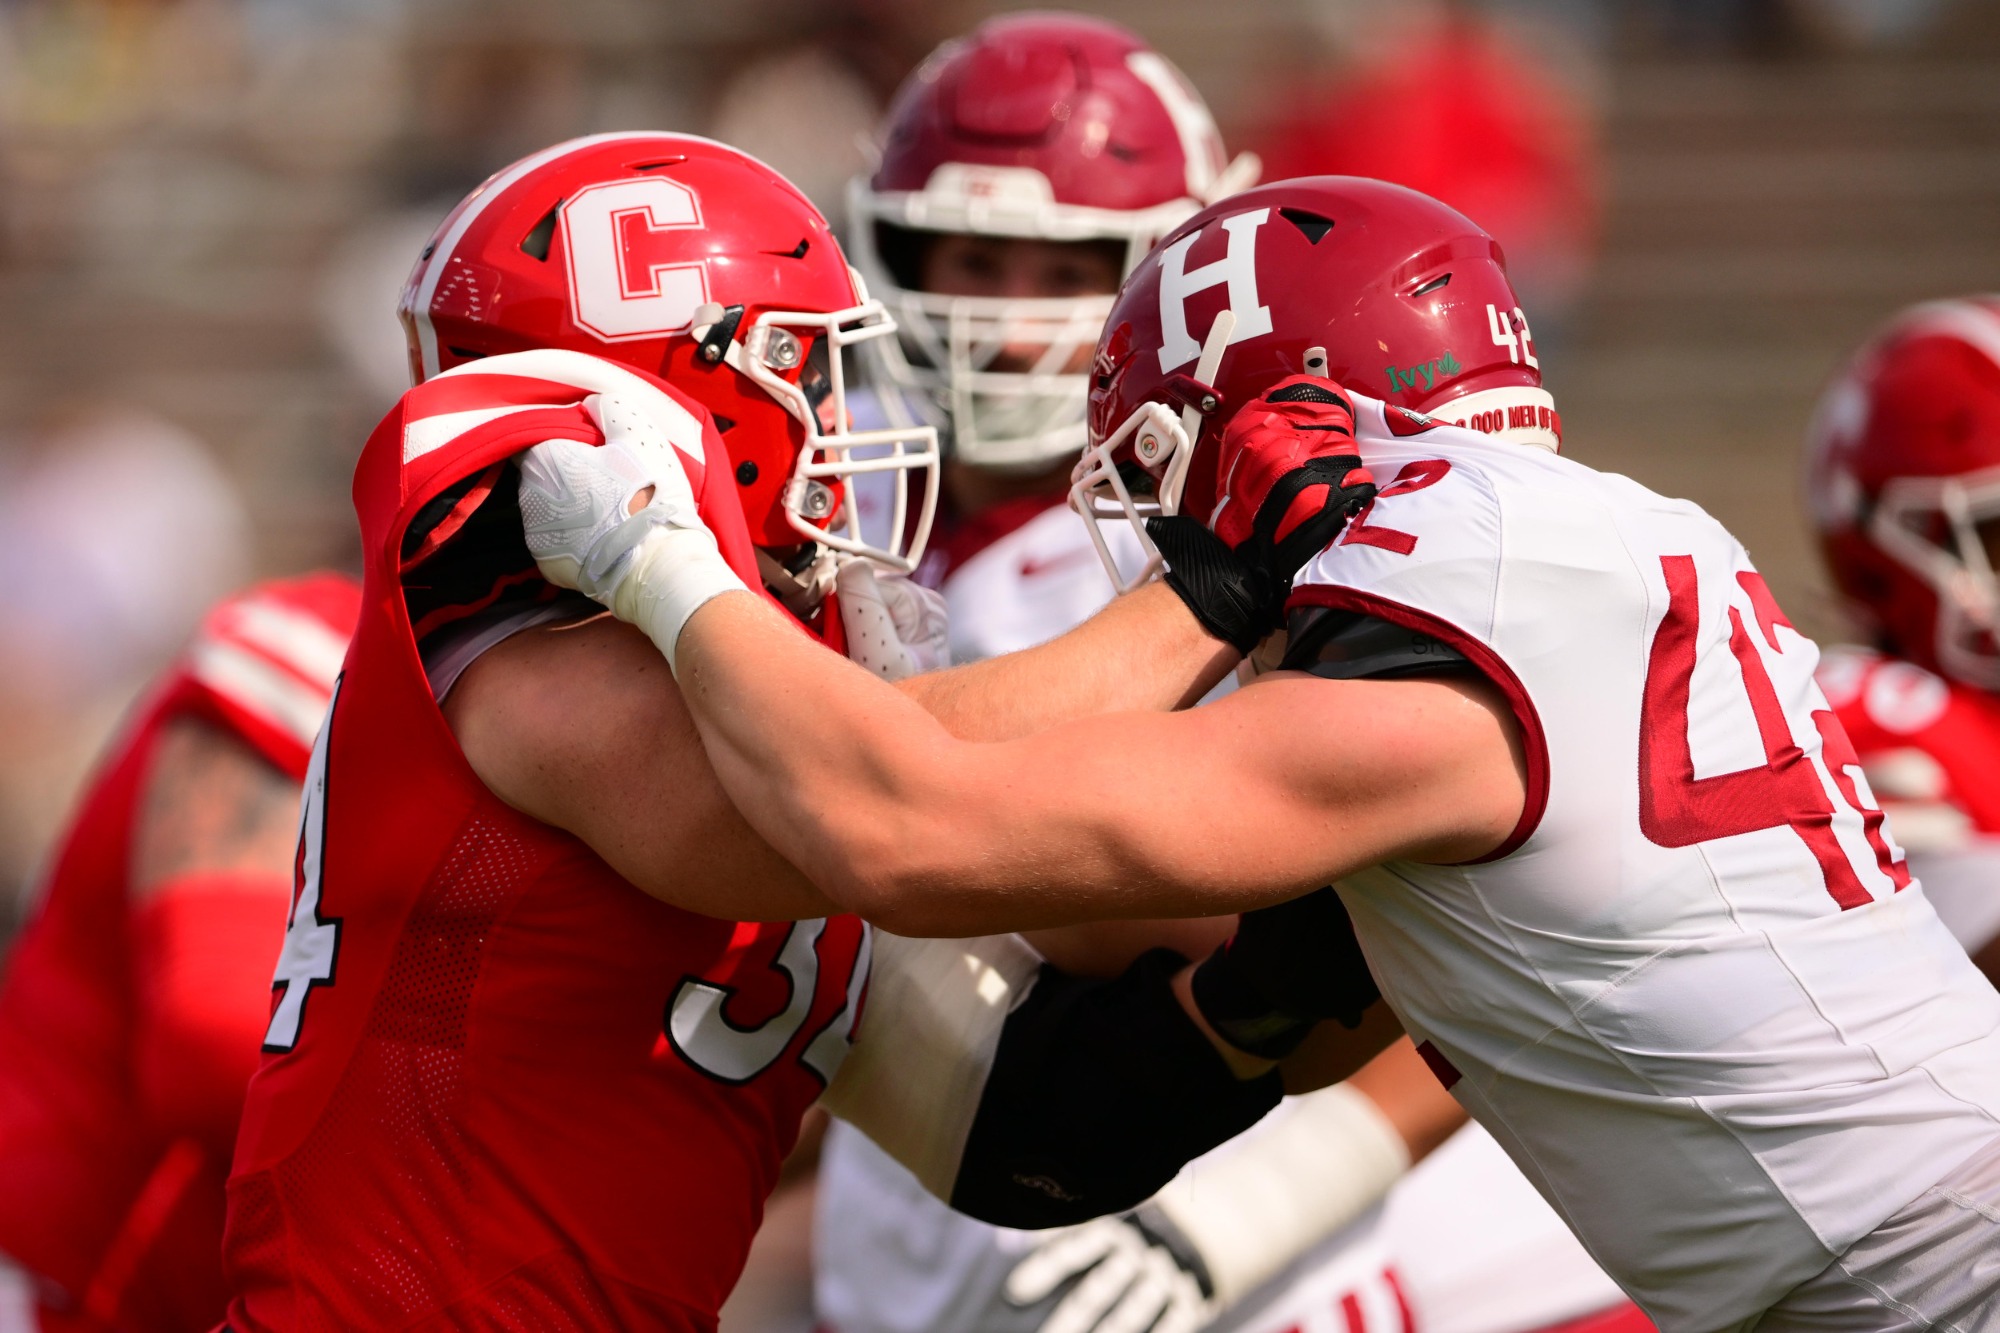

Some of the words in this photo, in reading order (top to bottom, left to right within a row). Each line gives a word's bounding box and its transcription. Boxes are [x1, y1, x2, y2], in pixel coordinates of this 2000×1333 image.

[556, 175, 711, 344] C
[1157, 207, 1273, 375] H
[1385, 360, 1434, 393] Ivy
[1486, 303, 1539, 370] 42
[1508, 405, 1536, 429] MEN
[1318, 458, 1452, 560] 2
